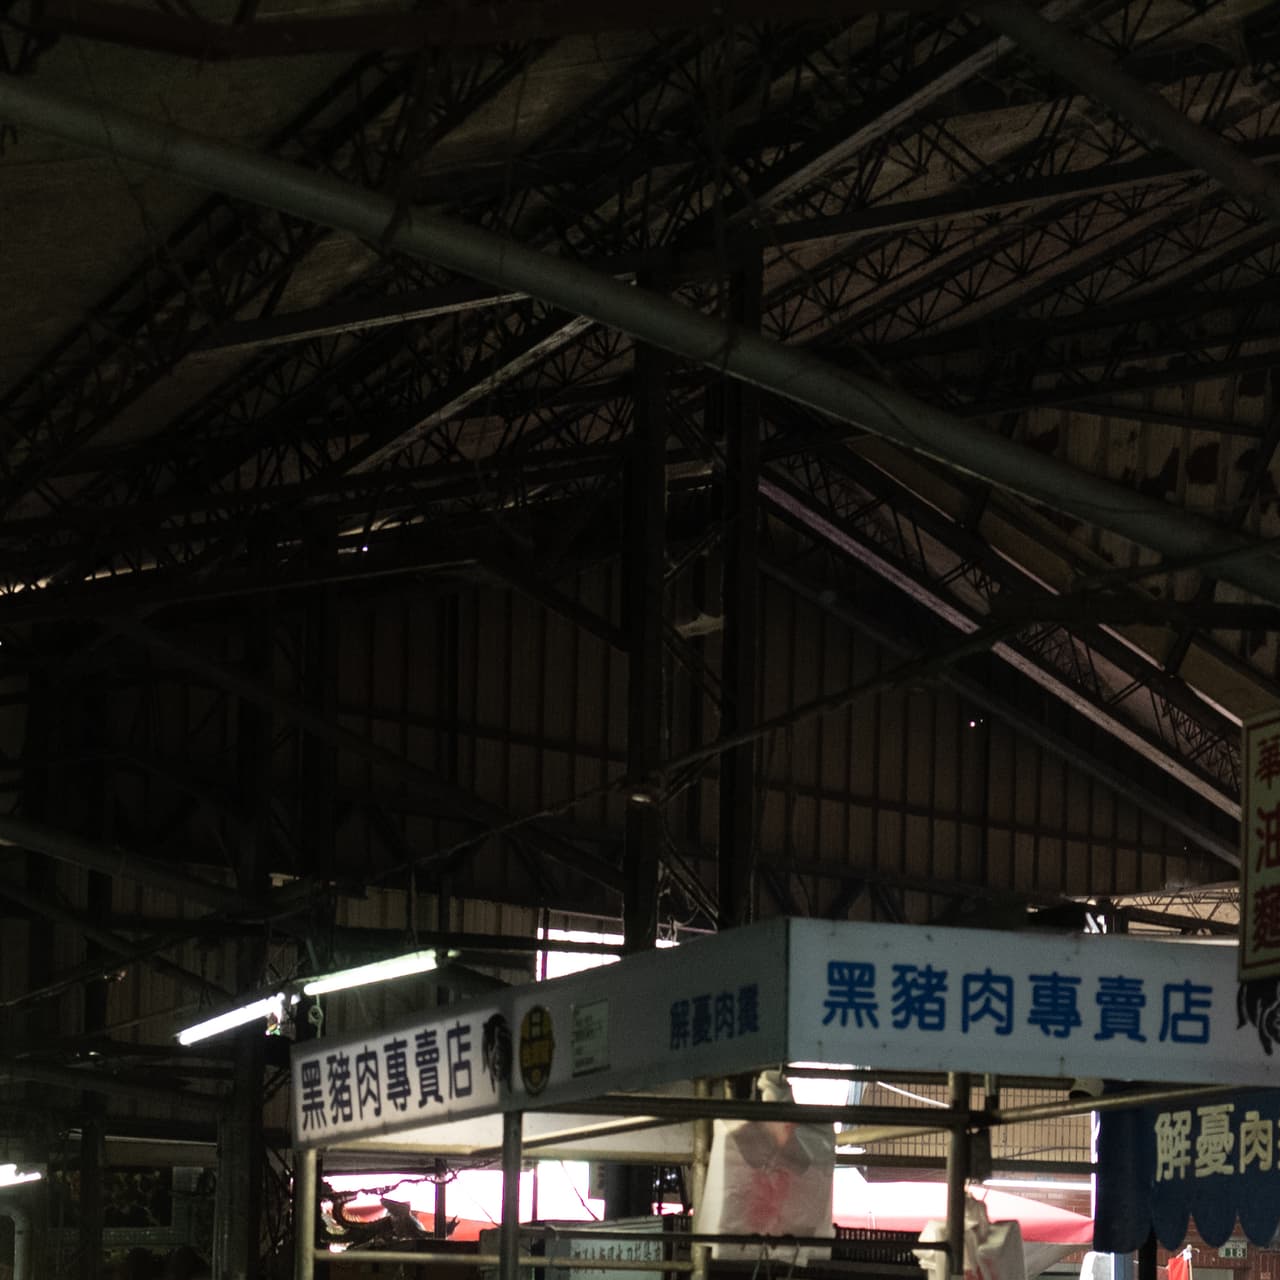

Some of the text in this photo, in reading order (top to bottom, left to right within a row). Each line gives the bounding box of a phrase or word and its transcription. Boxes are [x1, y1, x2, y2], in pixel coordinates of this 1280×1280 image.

[822, 961, 1213, 1044] 黑豬肉專賣店
[301, 1021, 473, 1130] 黑豬肉專賣店
